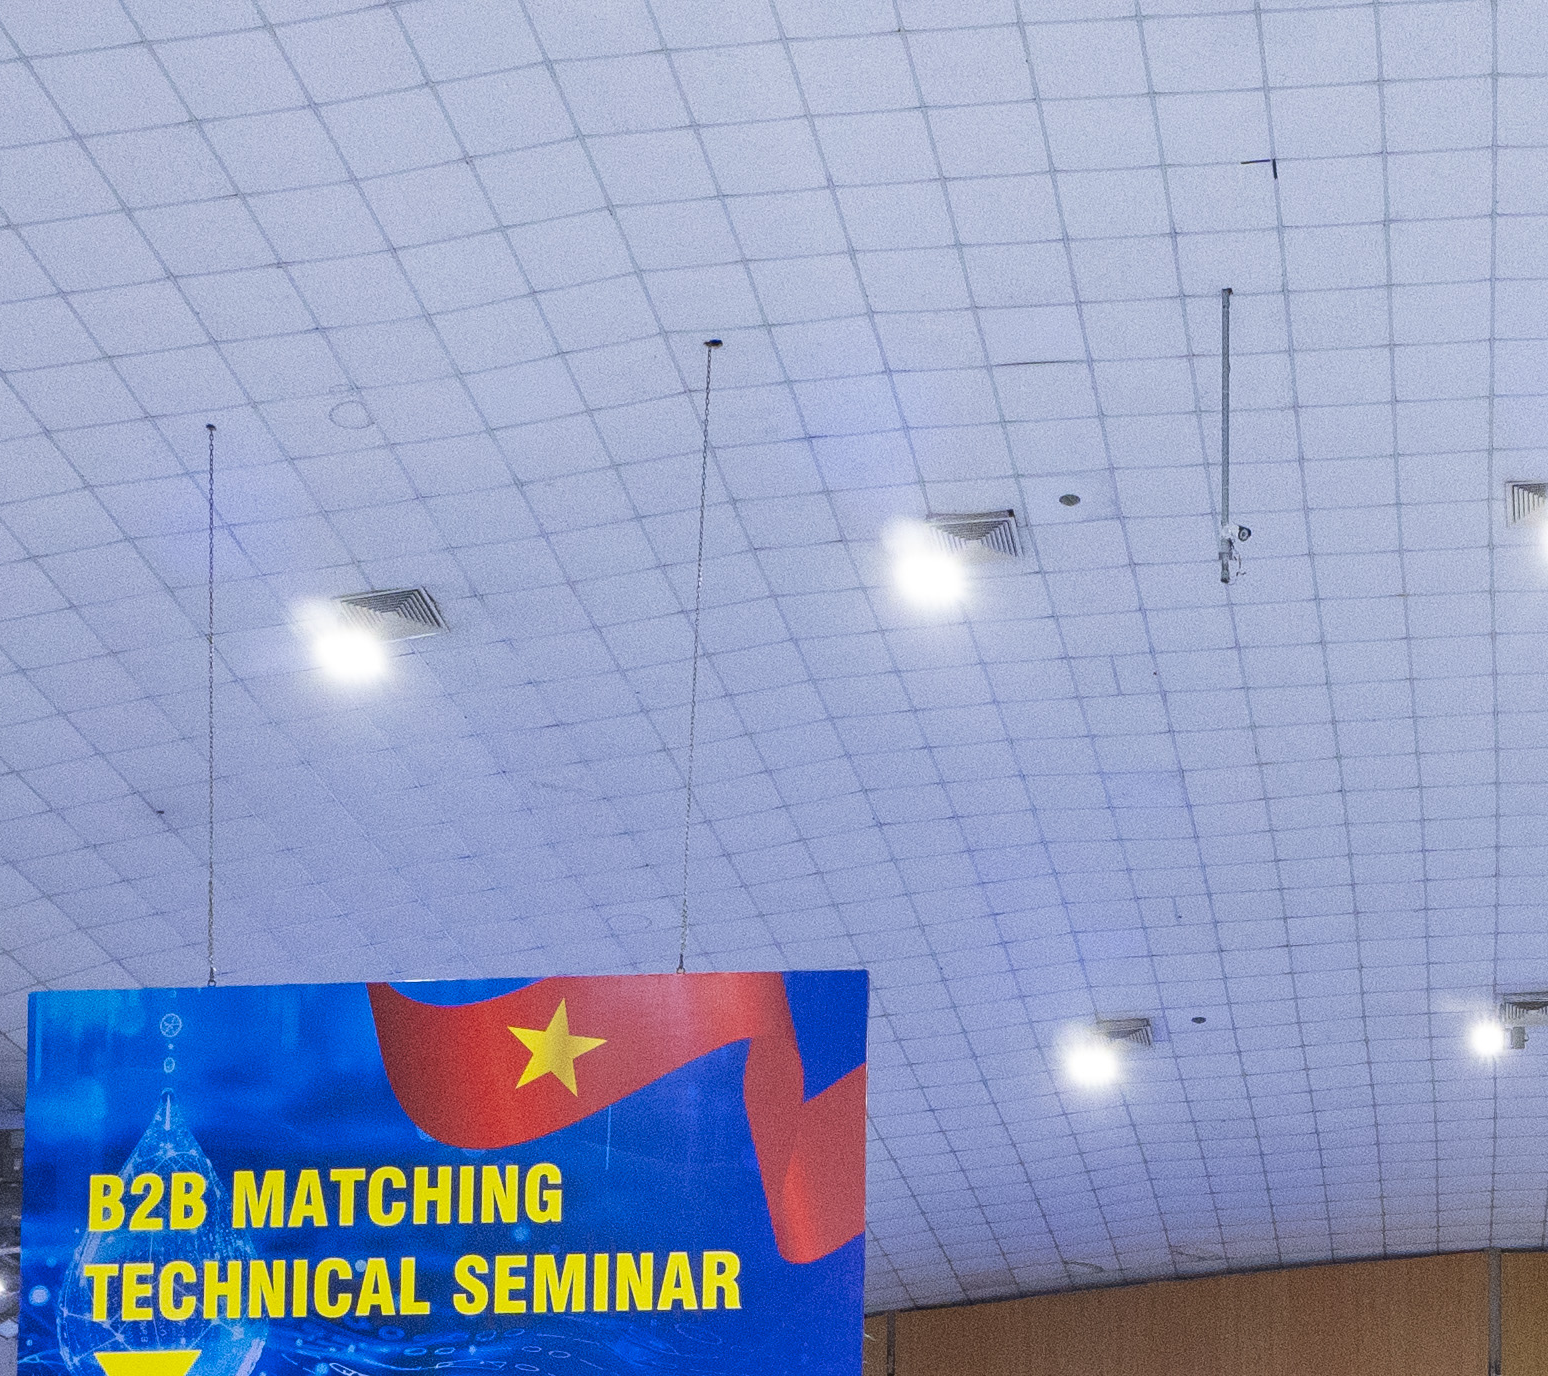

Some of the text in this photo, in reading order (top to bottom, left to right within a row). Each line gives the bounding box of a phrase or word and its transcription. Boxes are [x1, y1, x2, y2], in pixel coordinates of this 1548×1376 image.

[88, 1162, 564, 1233] B2B MATCHING
[85, 1251, 743, 1323] TECHNICAL SEMINAR
